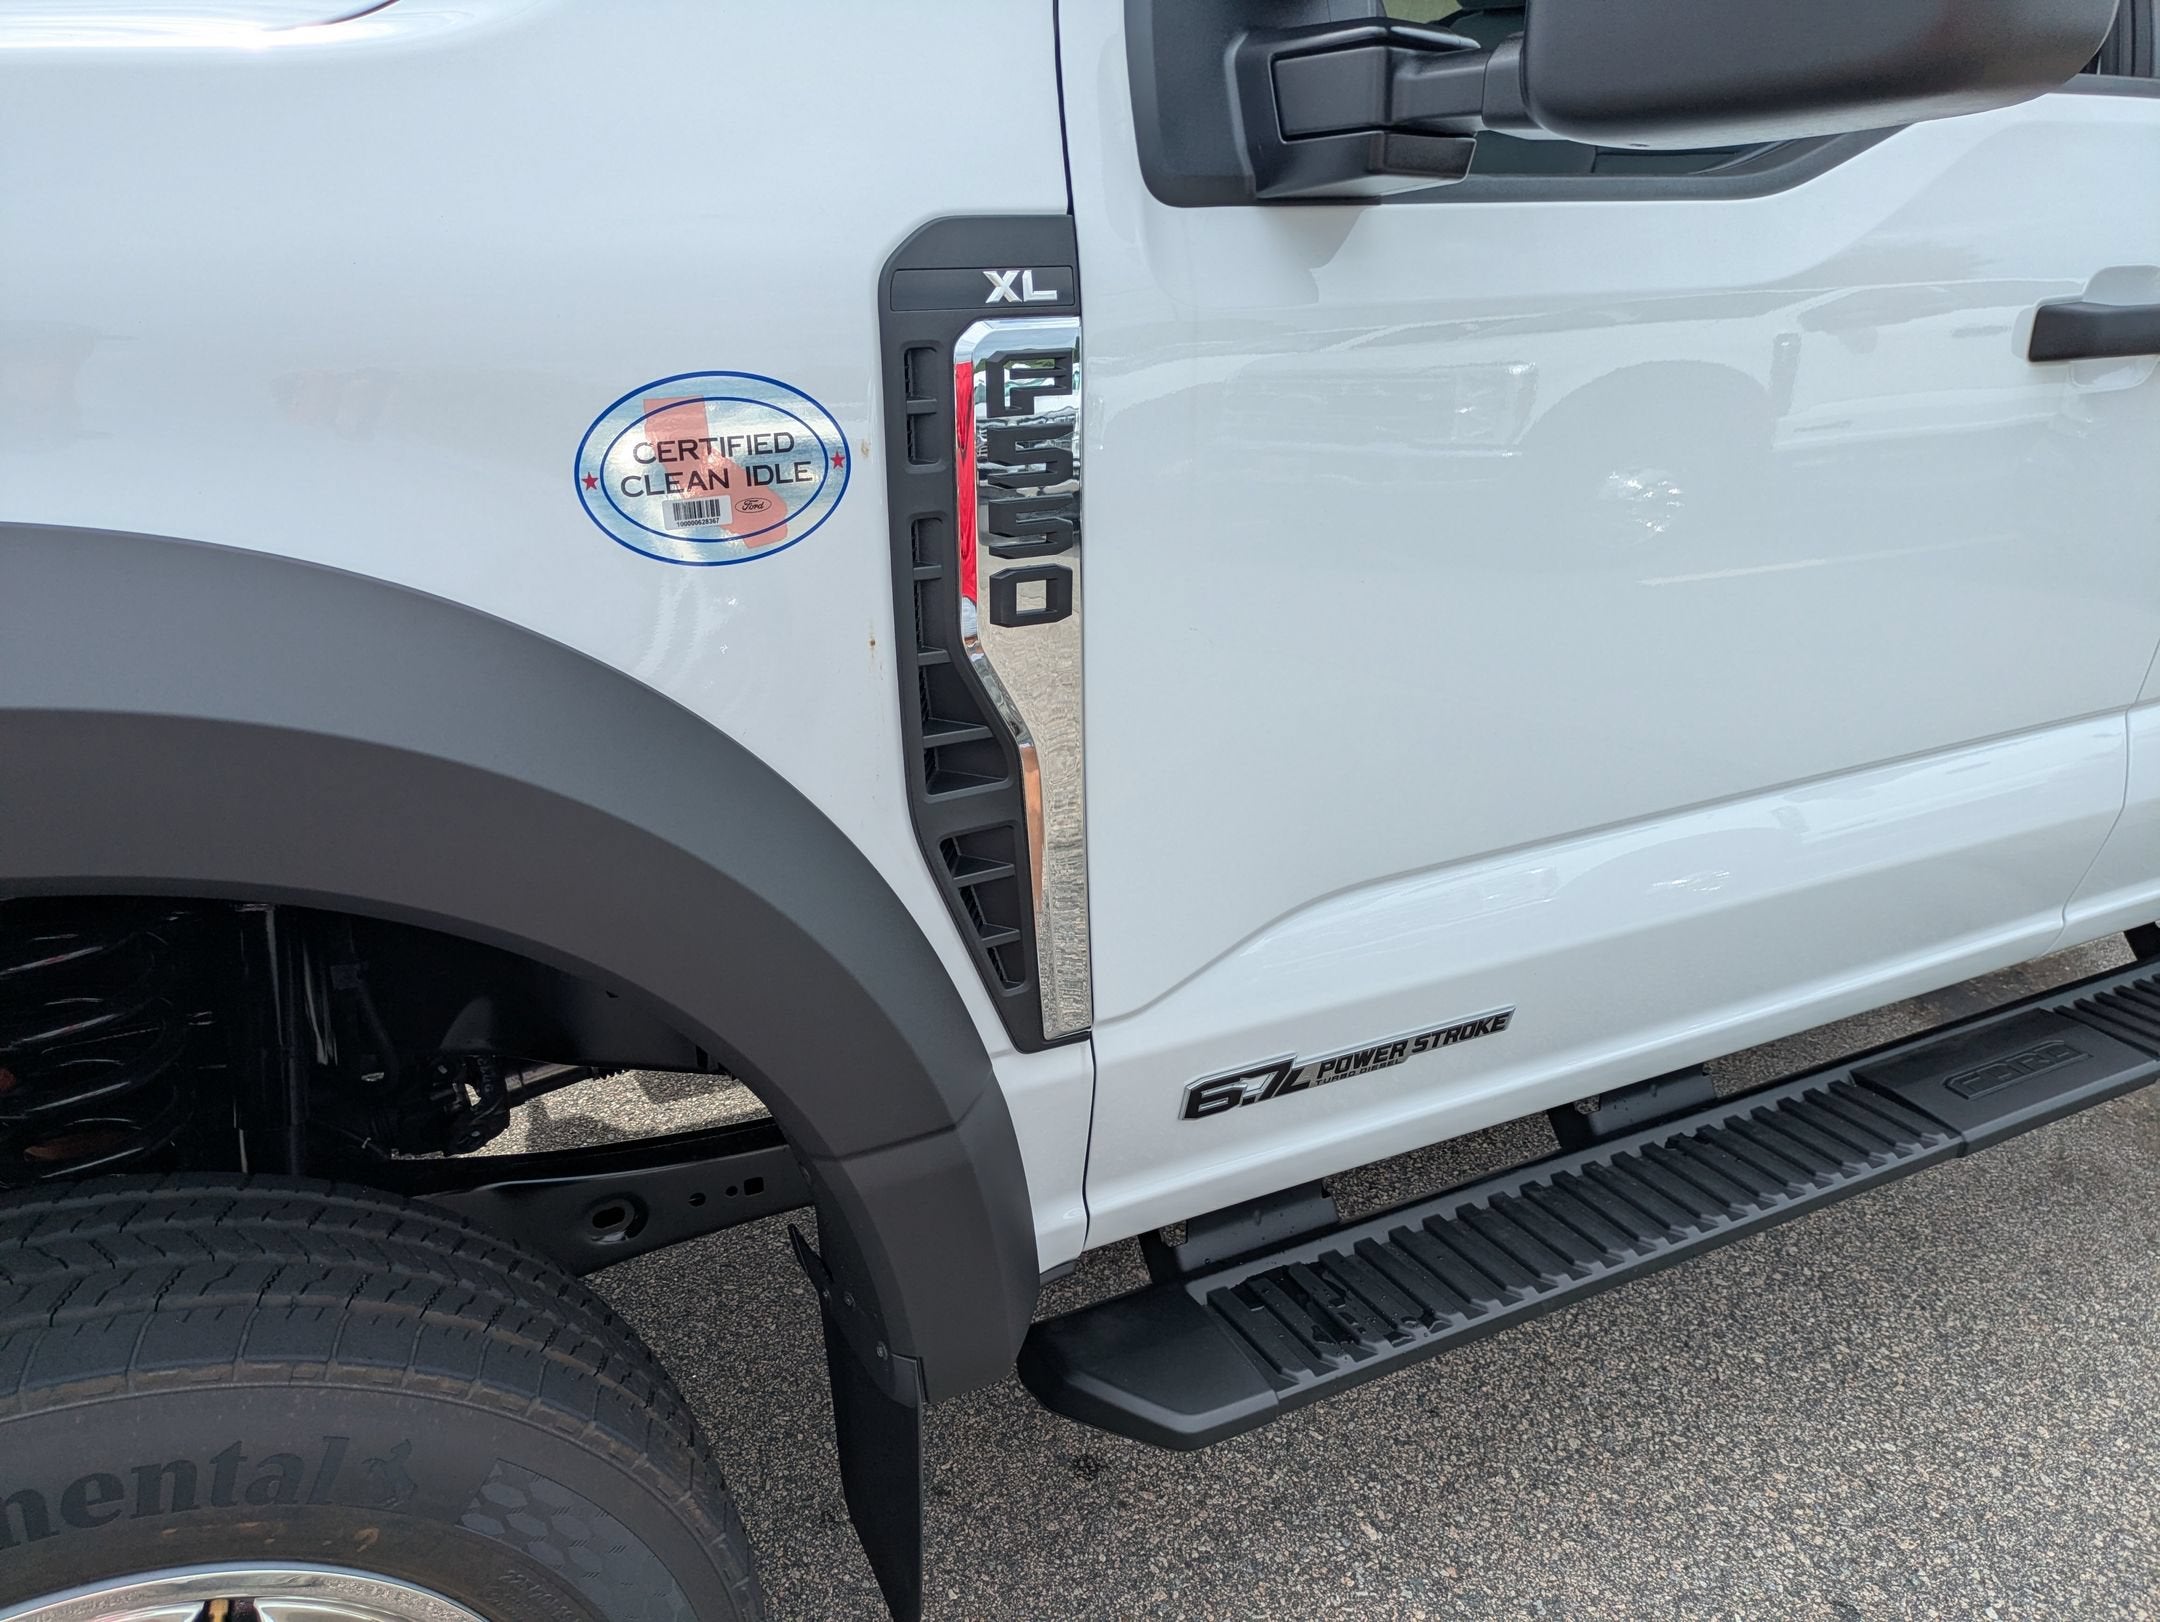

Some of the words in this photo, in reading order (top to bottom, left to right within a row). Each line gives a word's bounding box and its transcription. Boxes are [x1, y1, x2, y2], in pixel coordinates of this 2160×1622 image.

[982, 269, 1058, 304] XL
[632, 431, 795, 465] CERTIFIED
[620, 467, 730, 498] CLEAN
[745, 461, 813, 487] IDLE
[986, 347, 1074, 628] F550
[1183, 1056, 1311, 1120] 6.7L
[1316, 1037, 1409, 1080] POWER
[1411, 1011, 1511, 1054] STROKE
[1315, 1071, 1356, 1086] TURBO
[1359, 1058, 1402, 1075] DIESEL
